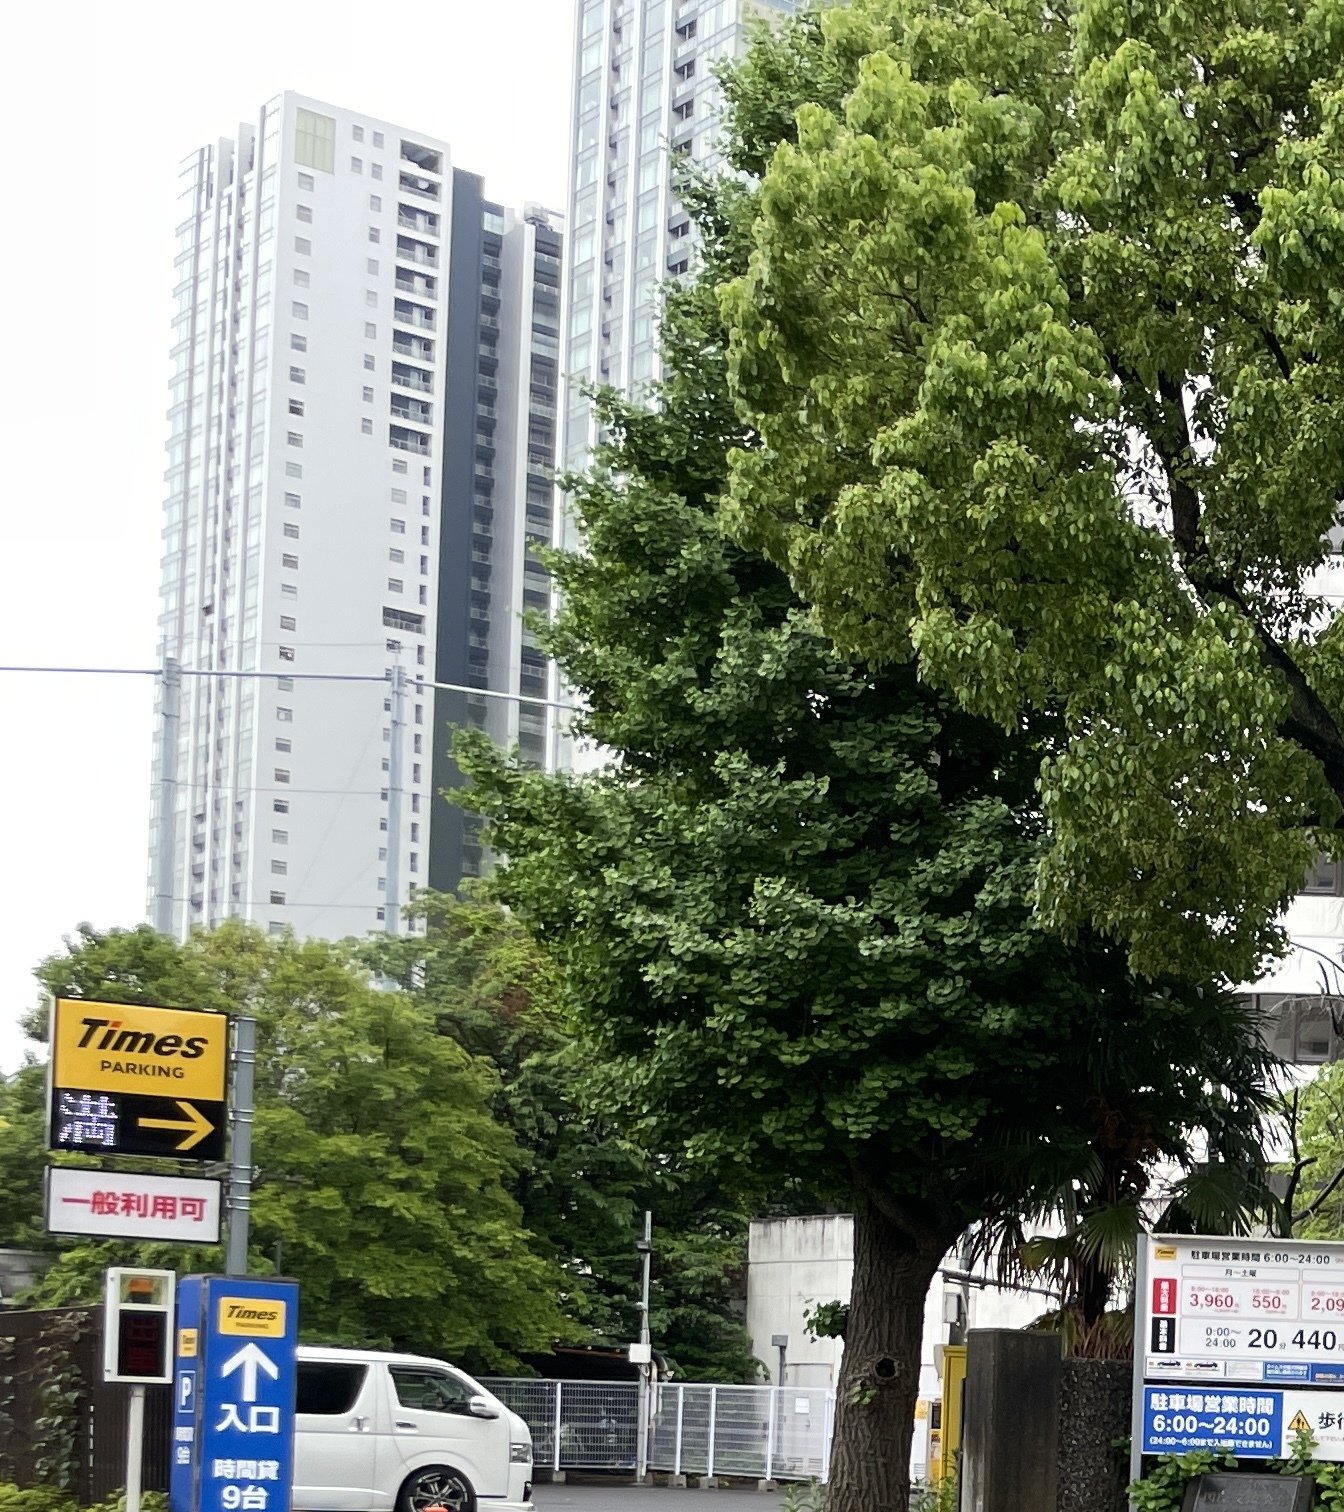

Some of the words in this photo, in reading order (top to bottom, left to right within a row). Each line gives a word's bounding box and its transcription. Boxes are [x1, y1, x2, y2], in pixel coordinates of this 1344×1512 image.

[77, 1017, 209, 1059] Times
[100, 1060, 185, 1079] PARKING
[61, 1190, 207, 1222] 一般利用可
[226, 1305, 278, 1321] Times
[1206, 1338, 1236, 1348] 24:00
[181, 1376, 192, 1407] P
[1150, 1393, 1274, 1415] 駐車場営業時間
[215, 1403, 280, 1434] 入口
[213, 1459, 279, 1481] 時間貸
[221, 1484, 269, 1511] 9台
